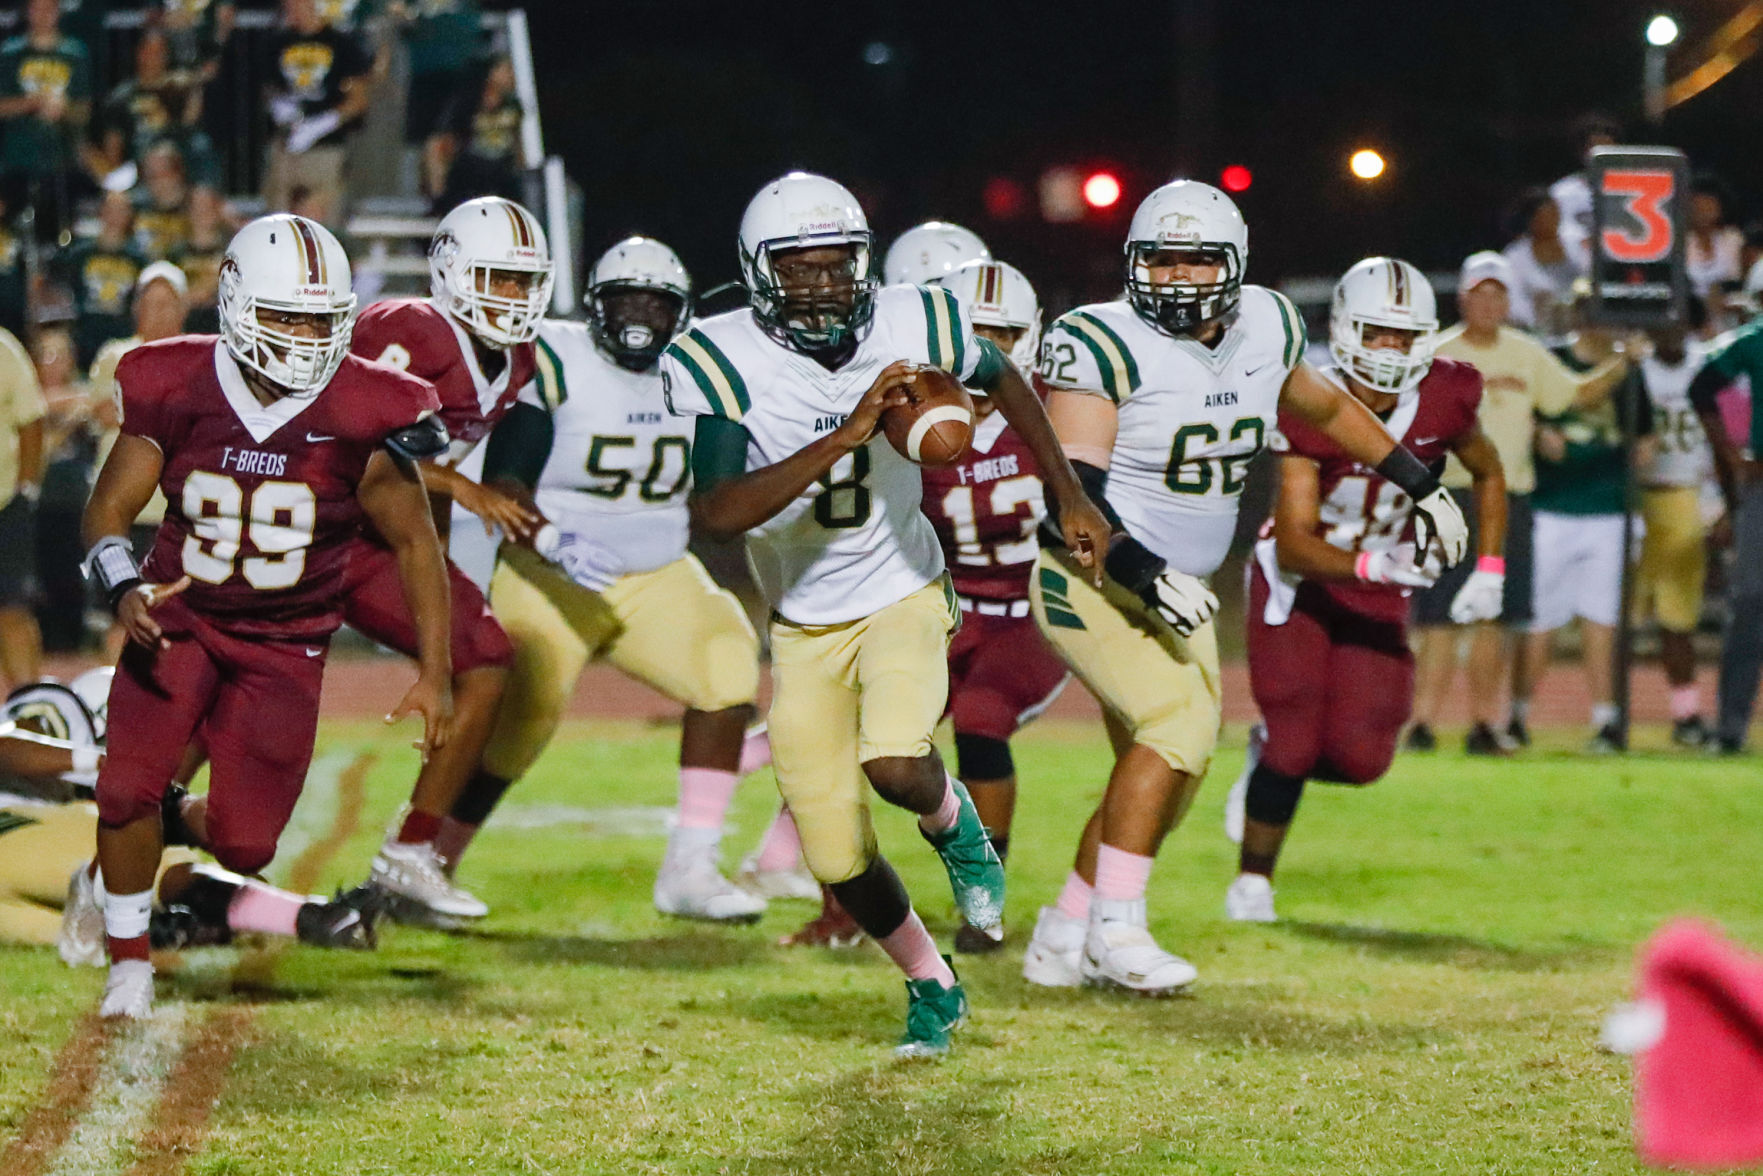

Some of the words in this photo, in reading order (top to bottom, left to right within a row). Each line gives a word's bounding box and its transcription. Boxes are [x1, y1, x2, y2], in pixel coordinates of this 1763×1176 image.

[809, 222, 838, 231] Riddell
[1602, 170, 1674, 263] 3
[303, 288, 328, 296] Riddell
[1204, 392, 1239, 408] AIKEN
[221, 446, 287, 477] T-BREDS
[574, 434, 693, 503] 50
[815, 442, 873, 529] 8
[956, 454, 1019, 485] T-BREDS
[1164, 416, 1266, 495] 62
[181, 469, 316, 590] 99
[942, 474, 1048, 567] 13
